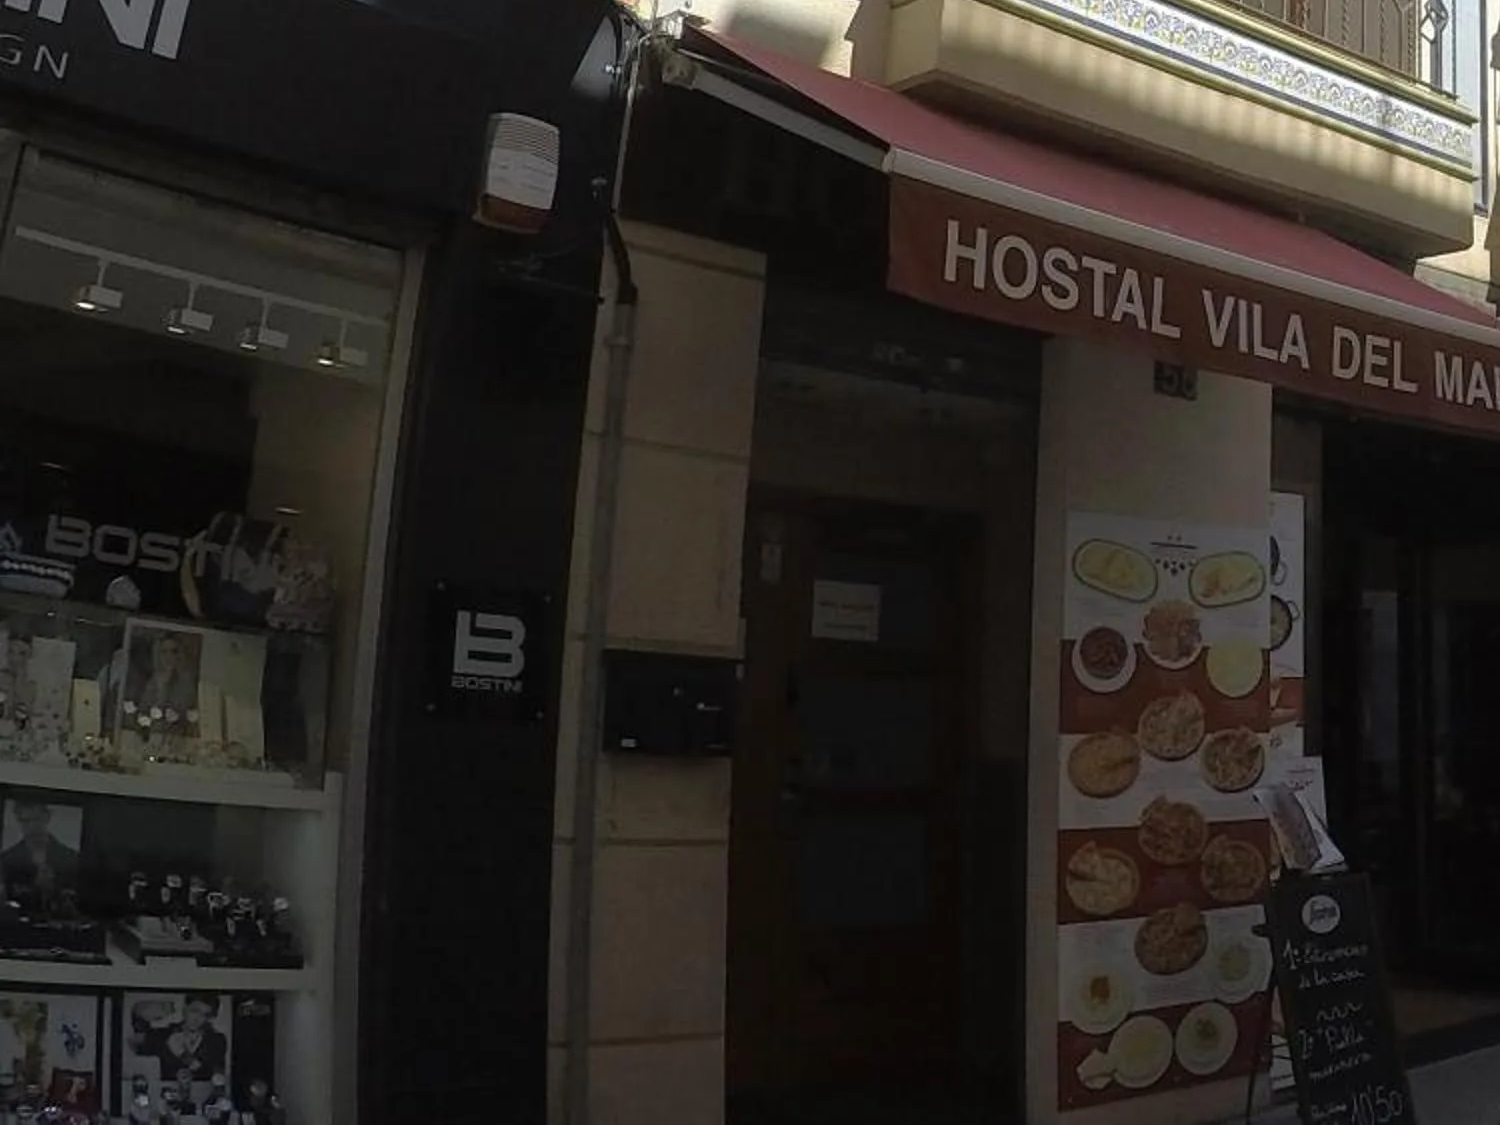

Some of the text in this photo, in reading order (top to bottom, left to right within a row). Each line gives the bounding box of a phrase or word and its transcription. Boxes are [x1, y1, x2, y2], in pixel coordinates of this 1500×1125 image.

[943, 219, 1183, 340] HOSTAL
[1203, 288, 1310, 370] VILA
[1332, 327, 1418, 394] DEL
[450, 675, 524, 693] BOSTINI
